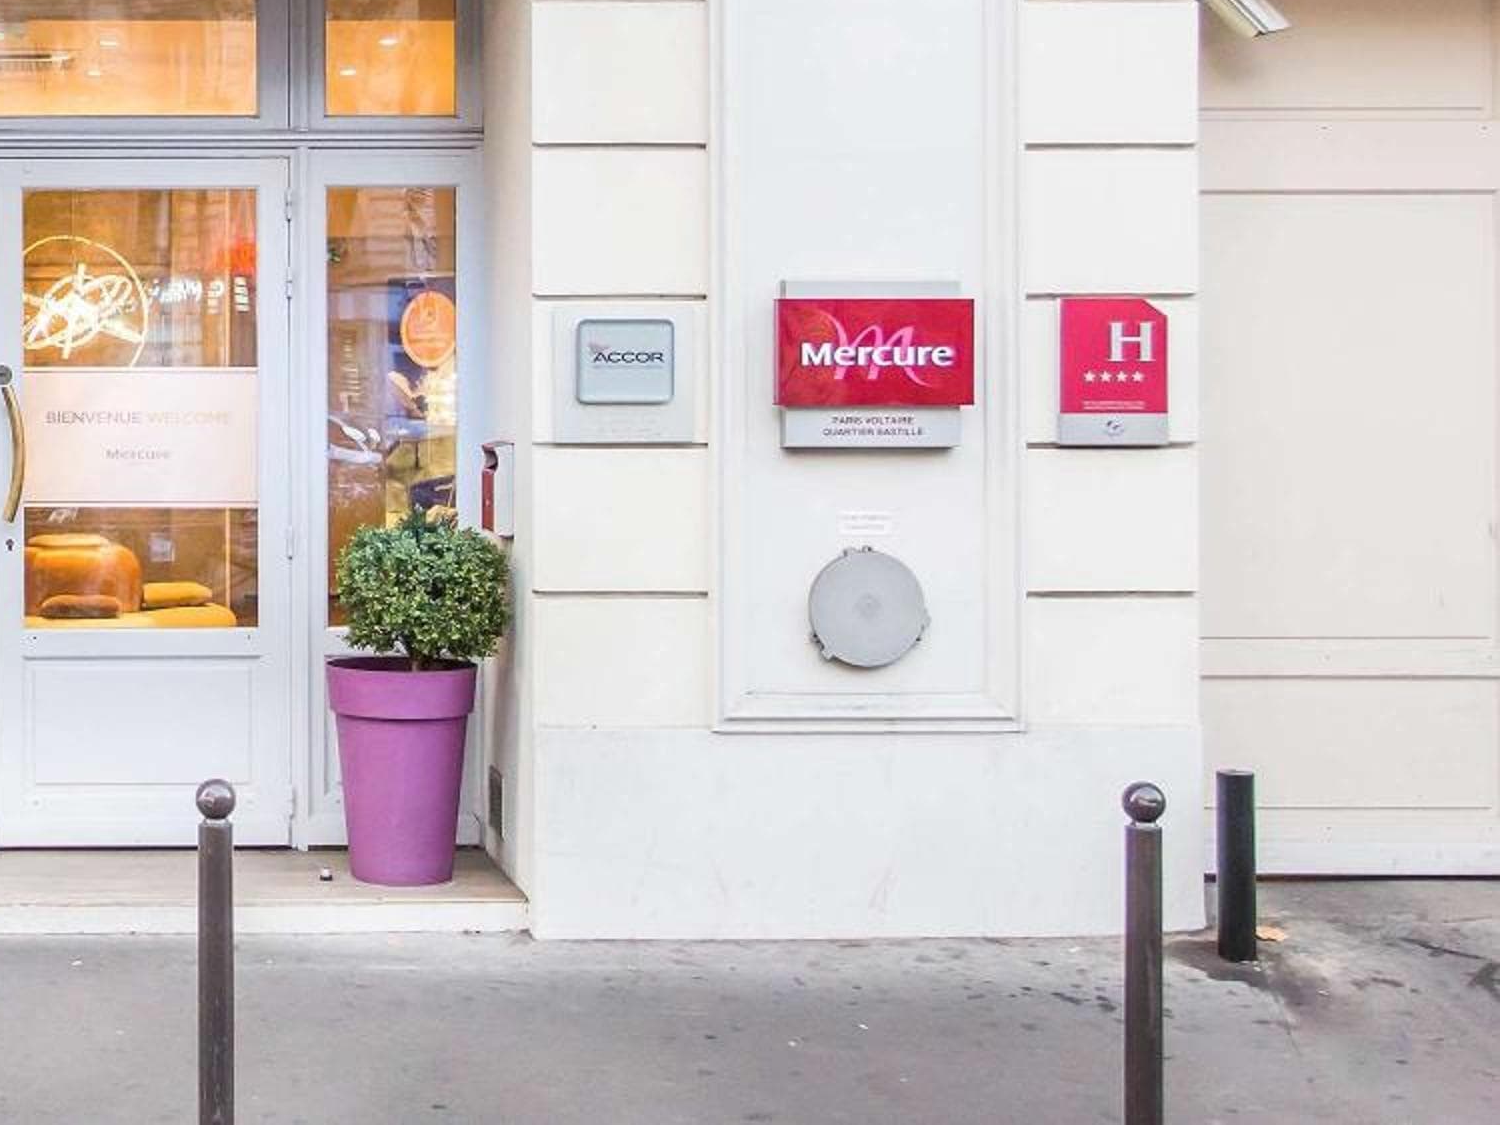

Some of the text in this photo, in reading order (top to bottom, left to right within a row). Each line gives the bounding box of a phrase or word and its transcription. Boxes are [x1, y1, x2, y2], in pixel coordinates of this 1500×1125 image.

[1107, 321, 1157, 363] H
[592, 351, 665, 364] ACCOR
[800, 341, 957, 367] Mercure
[46, 410, 141, 424] BIENVENUE
